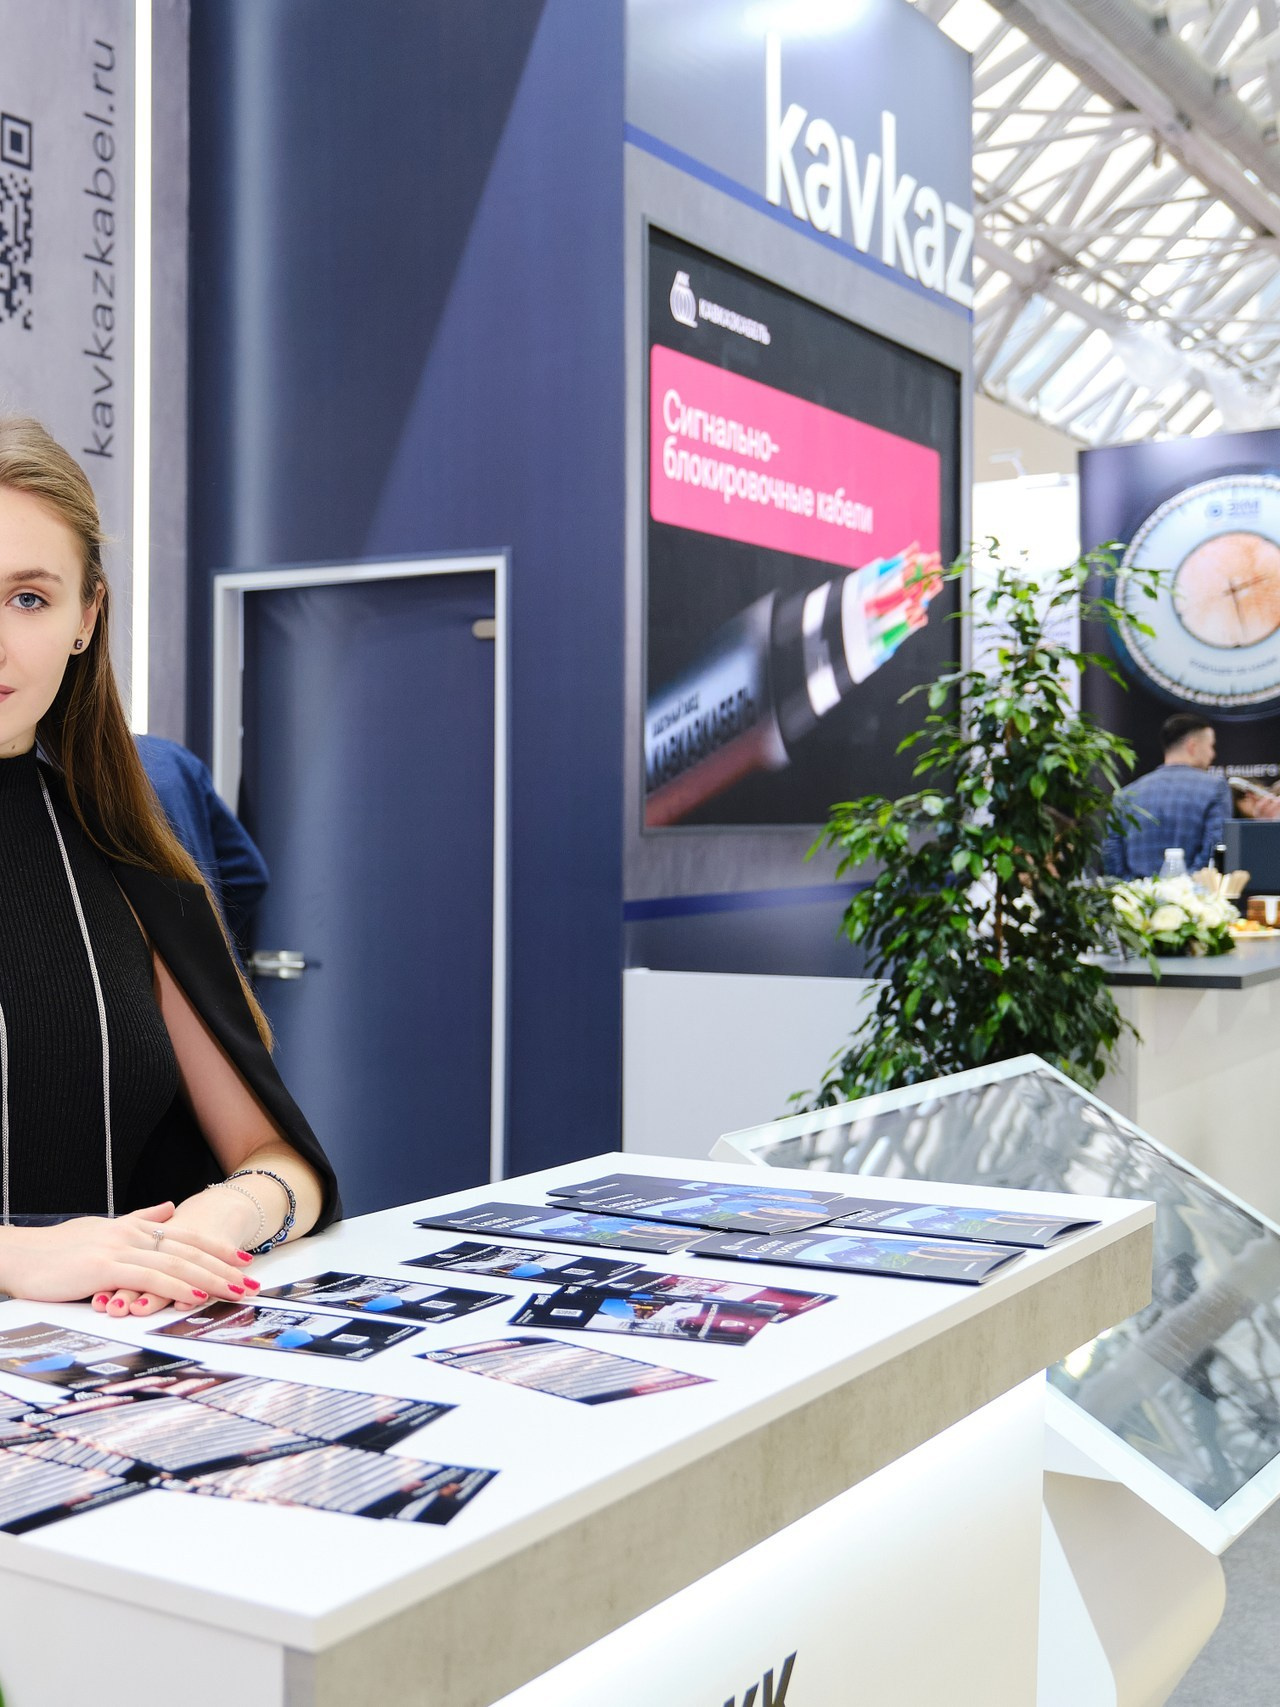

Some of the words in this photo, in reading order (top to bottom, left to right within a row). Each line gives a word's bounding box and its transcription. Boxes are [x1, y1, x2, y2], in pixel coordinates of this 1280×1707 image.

[83, 39, 116, 459] kavkazkabel.ru
[766, 30, 975, 309] kavkaz
[663, 388, 780, 463] Сигнально-
[663, 435, 815, 518] блокировочные
[816, 487, 874, 535] кабели
